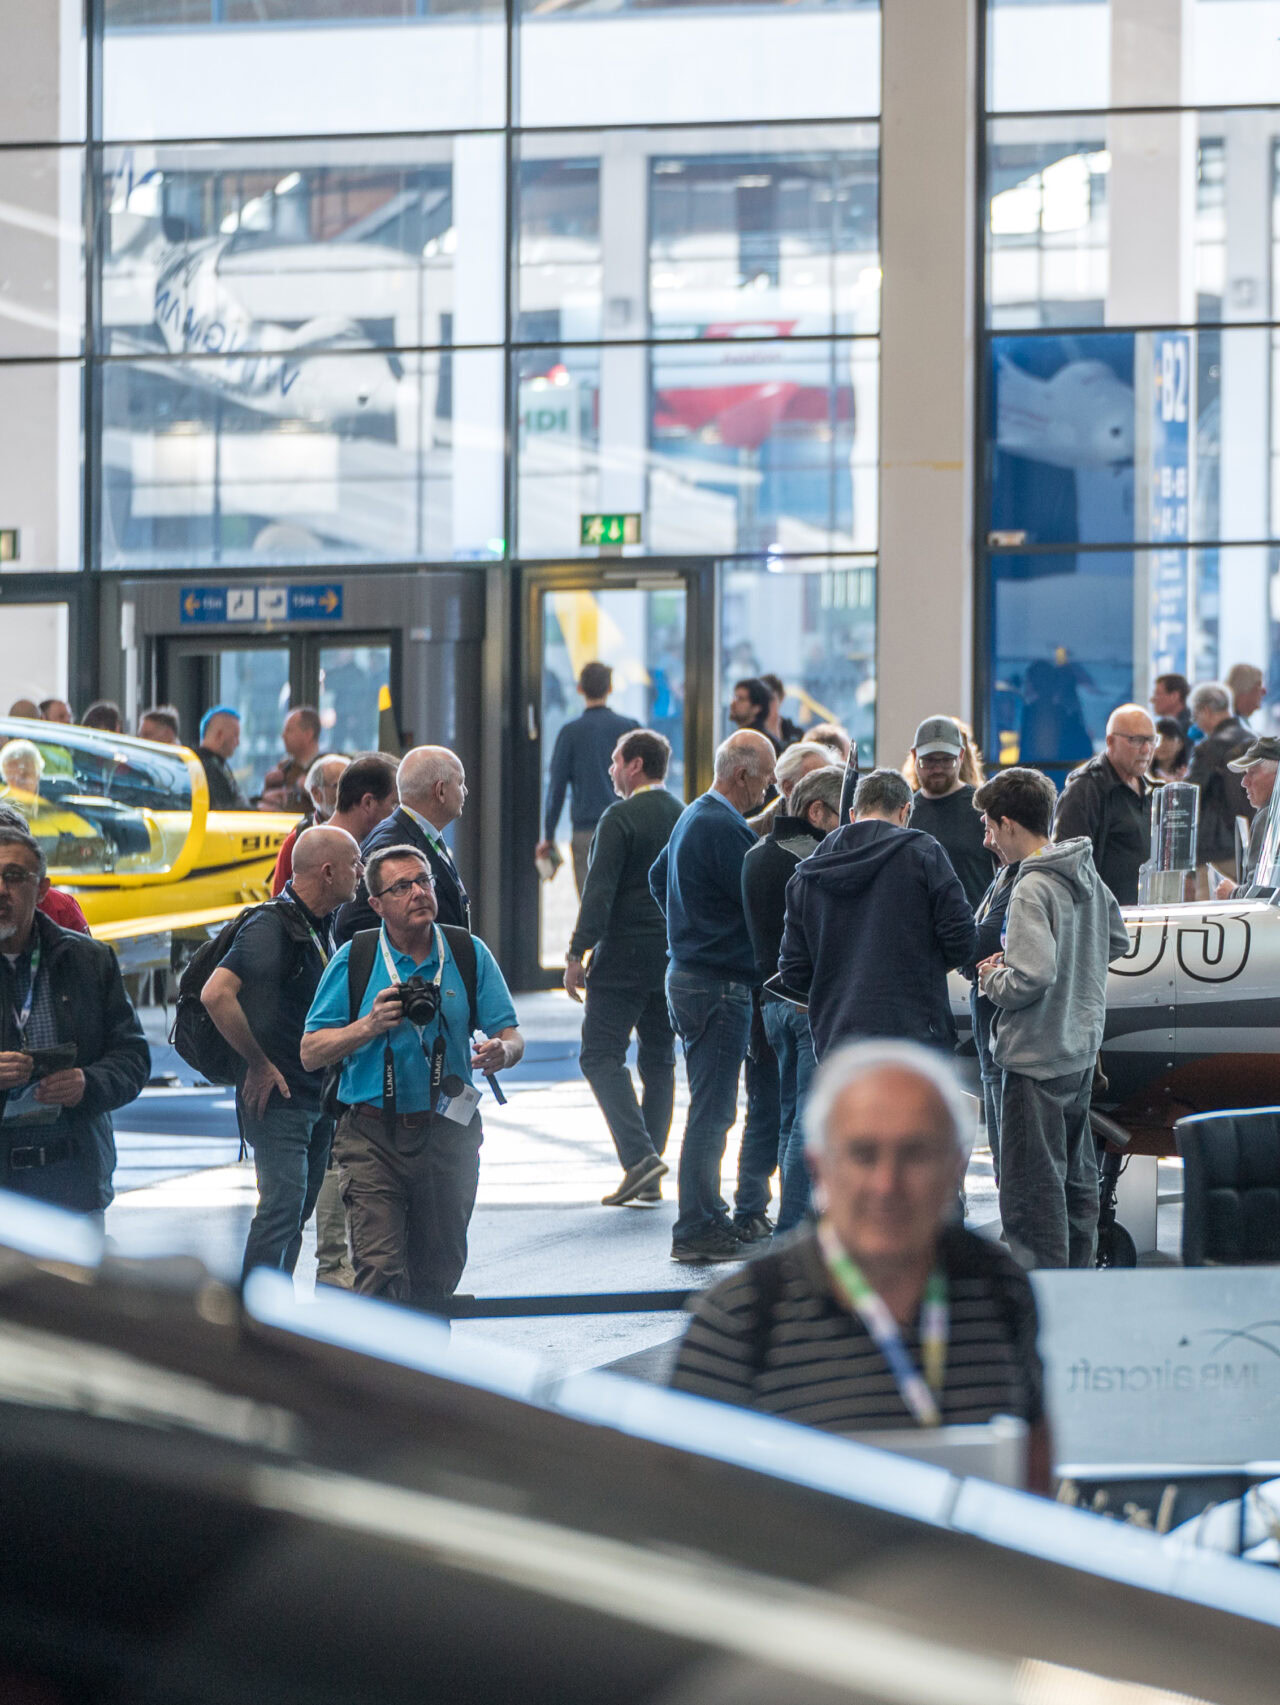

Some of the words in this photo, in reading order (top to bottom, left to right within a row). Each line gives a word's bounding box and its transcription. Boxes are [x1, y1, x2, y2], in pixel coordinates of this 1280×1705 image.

[1161, 340, 1187, 422] B2
[385, 1064, 394, 1097] LUMIX
[431, 1053, 443, 1086] LUMIX
